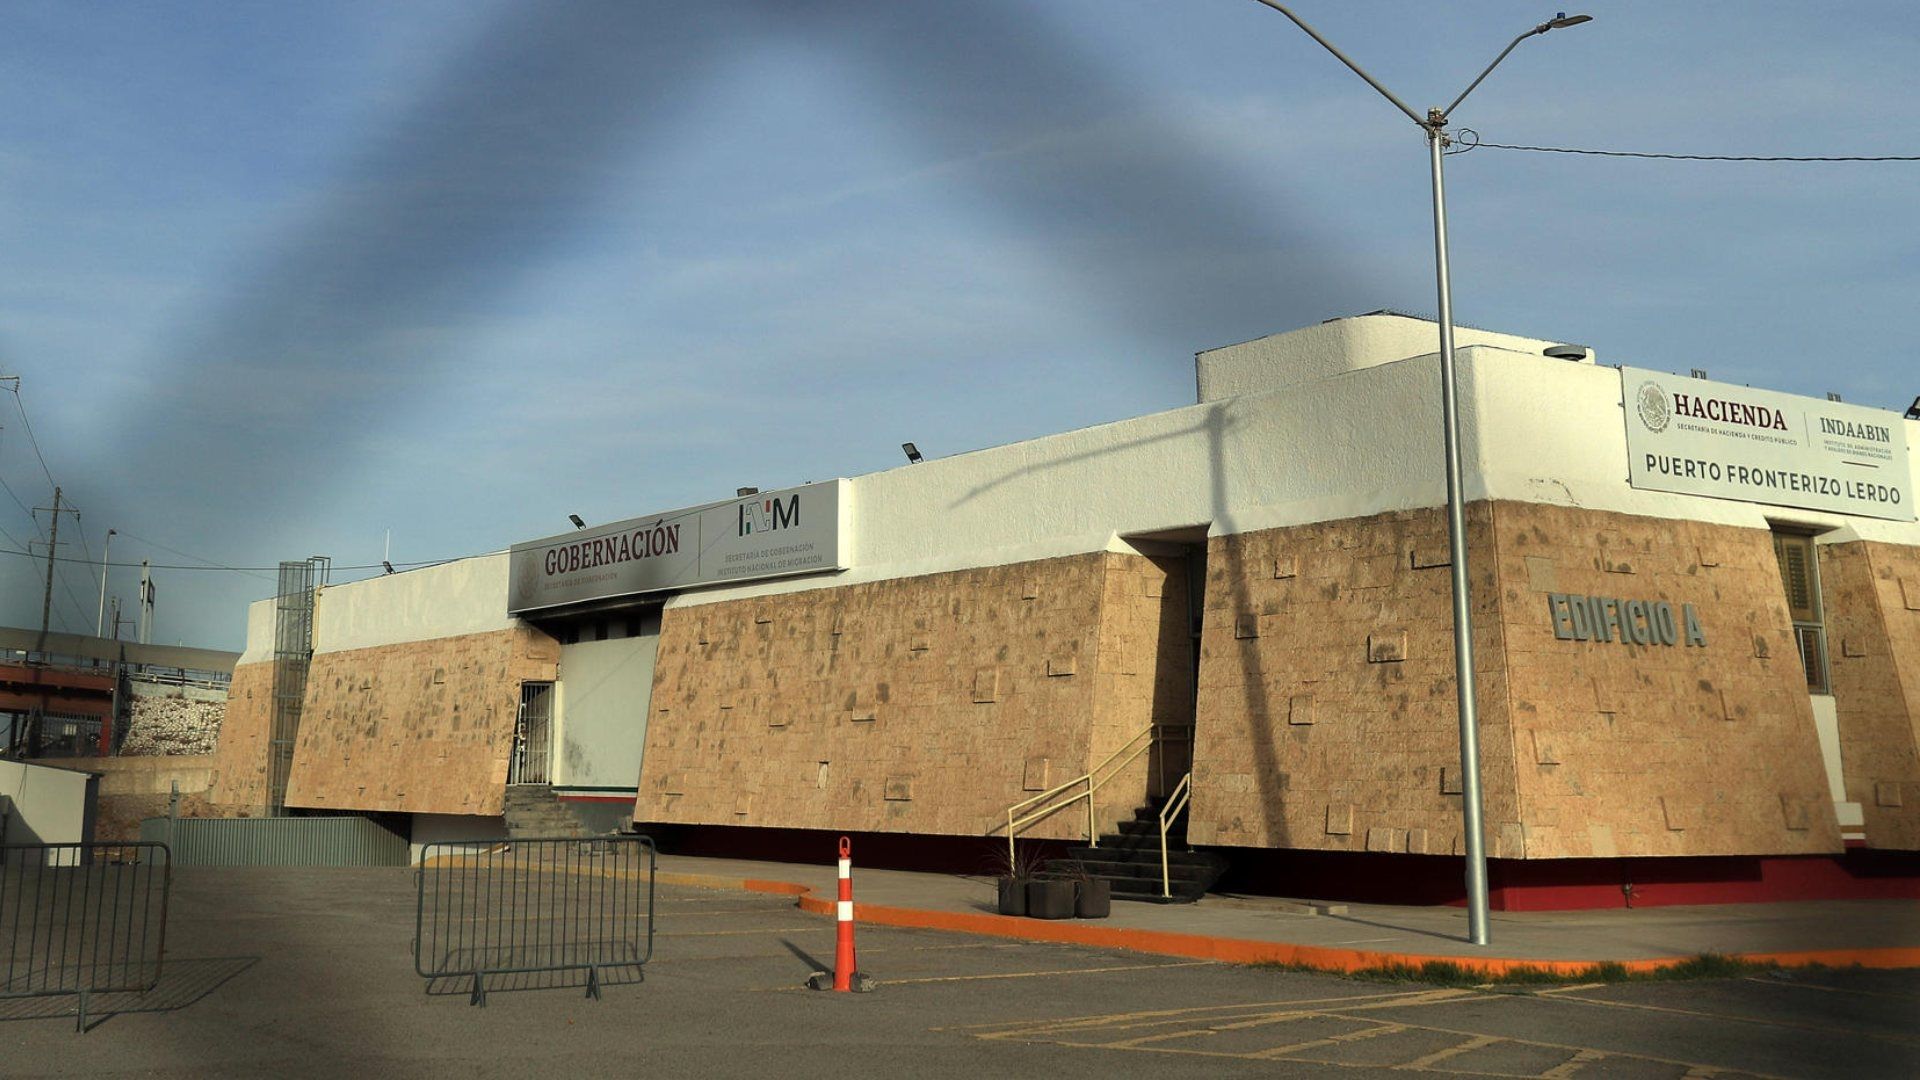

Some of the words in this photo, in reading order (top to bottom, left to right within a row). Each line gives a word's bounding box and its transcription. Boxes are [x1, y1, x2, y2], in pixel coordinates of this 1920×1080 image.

[1673, 393, 1788, 431] HACIENDA
[1719, 430, 1746, 439] HACIENDA
[1820, 417, 1890, 443] INDAABIN
[1646, 453, 1721, 481] PUERTO
[1727, 465, 1841, 496] FRONTERIZO
[1847, 480, 1901, 505] LERDO
[545, 519, 681, 576] GOBERNACIÓN
[1548, 592, 1677, 647] EDIFICIO
[1682, 603, 1707, 648] A
